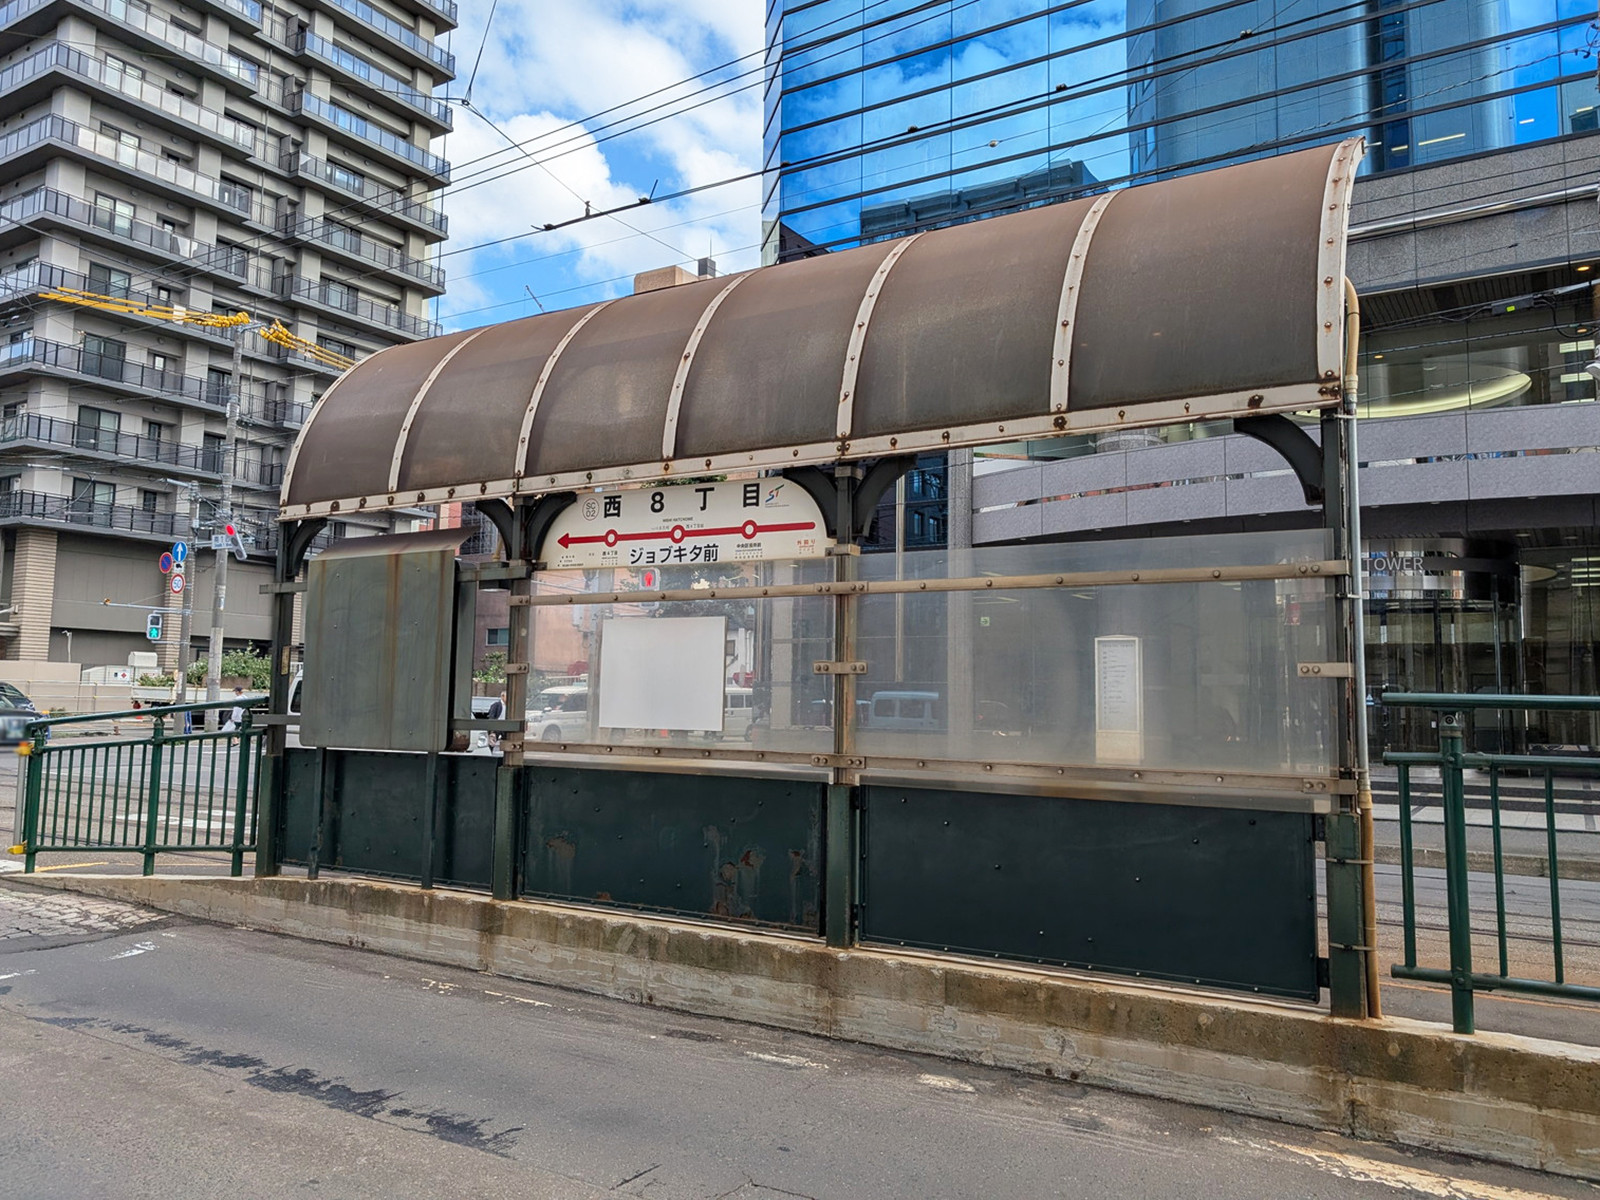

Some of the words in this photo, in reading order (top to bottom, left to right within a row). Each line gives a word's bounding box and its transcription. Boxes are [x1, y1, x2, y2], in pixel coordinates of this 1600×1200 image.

[585, 502, 596, 510] SC
[604, 483, 760, 518] 西8丁目
[585, 510, 596, 518] 02
[629, 544, 719, 564] ジョブキタ前
[1363, 557, 1423, 570] TOWER
